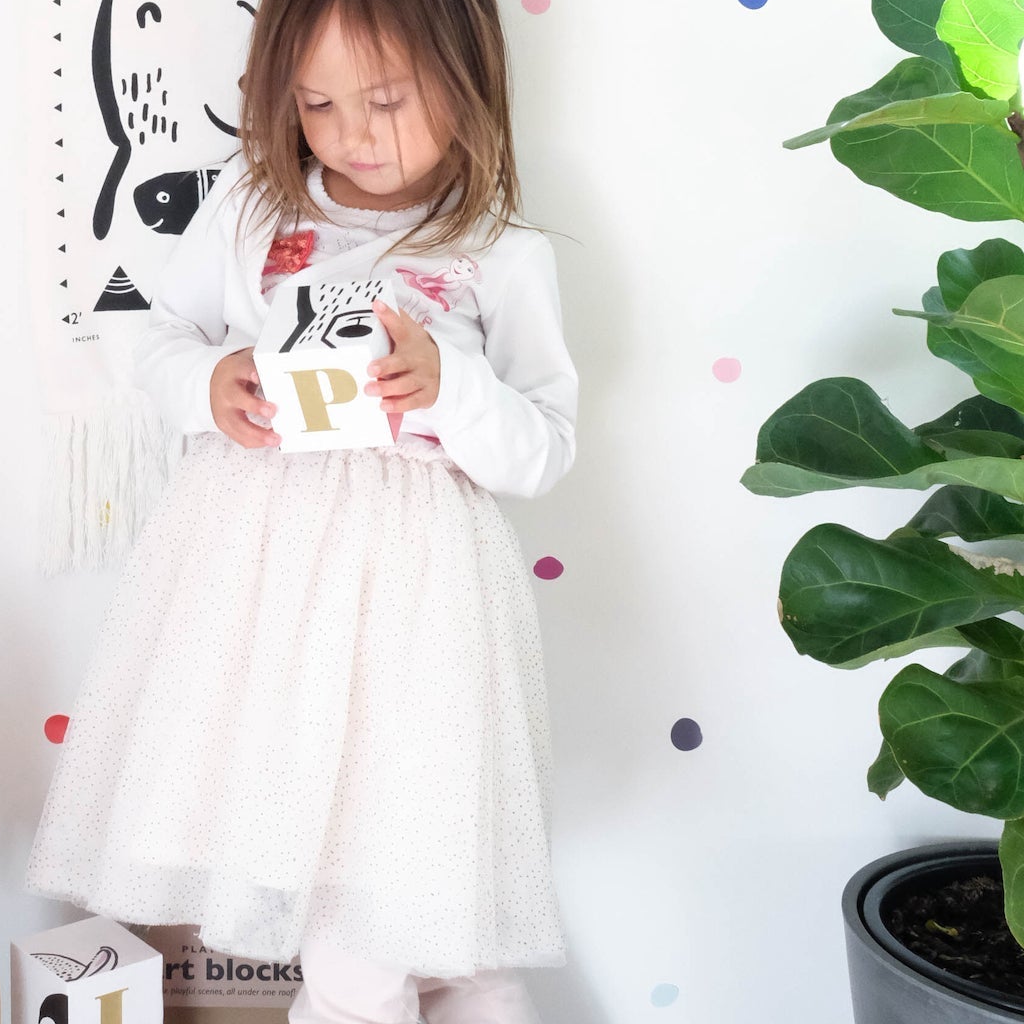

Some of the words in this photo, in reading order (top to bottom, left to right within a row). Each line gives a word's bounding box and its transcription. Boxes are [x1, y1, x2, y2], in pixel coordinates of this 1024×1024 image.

[72, 334, 100, 343] INCHES
[284, 368, 358, 432] P
[163, 959, 194, 980] rt
[206, 958, 304, 982] blocks
[226, 987, 236, 995] all
[237, 987, 259, 996] under
